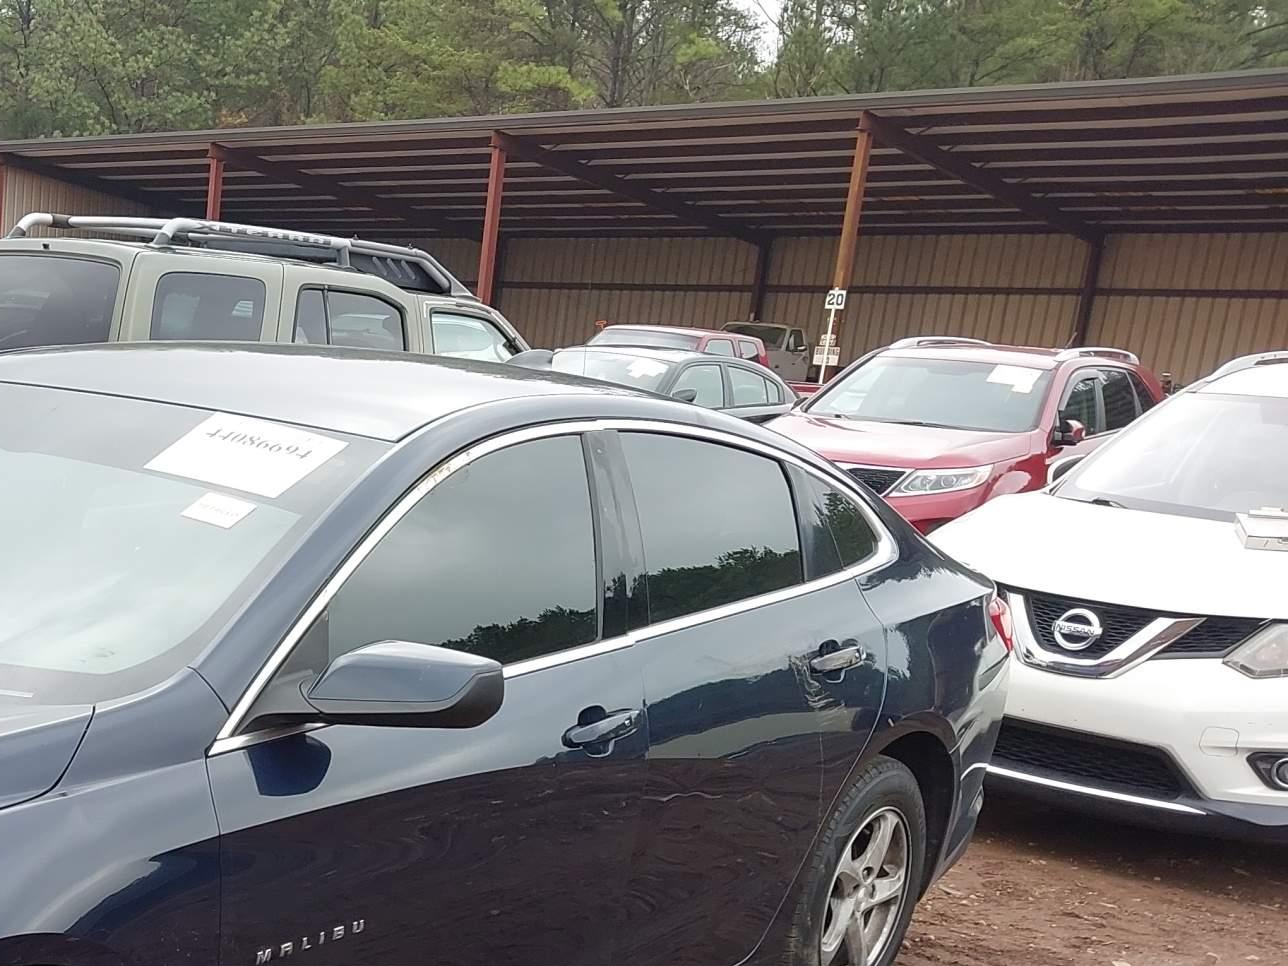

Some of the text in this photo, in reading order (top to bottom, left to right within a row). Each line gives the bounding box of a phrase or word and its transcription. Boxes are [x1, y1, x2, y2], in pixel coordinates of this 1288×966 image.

[827, 293, 844, 306] 20
[206, 428, 313, 459] 44086694
[1055, 622, 1096, 637] NISSAN
[256, 919, 365, 965] MALIBU
